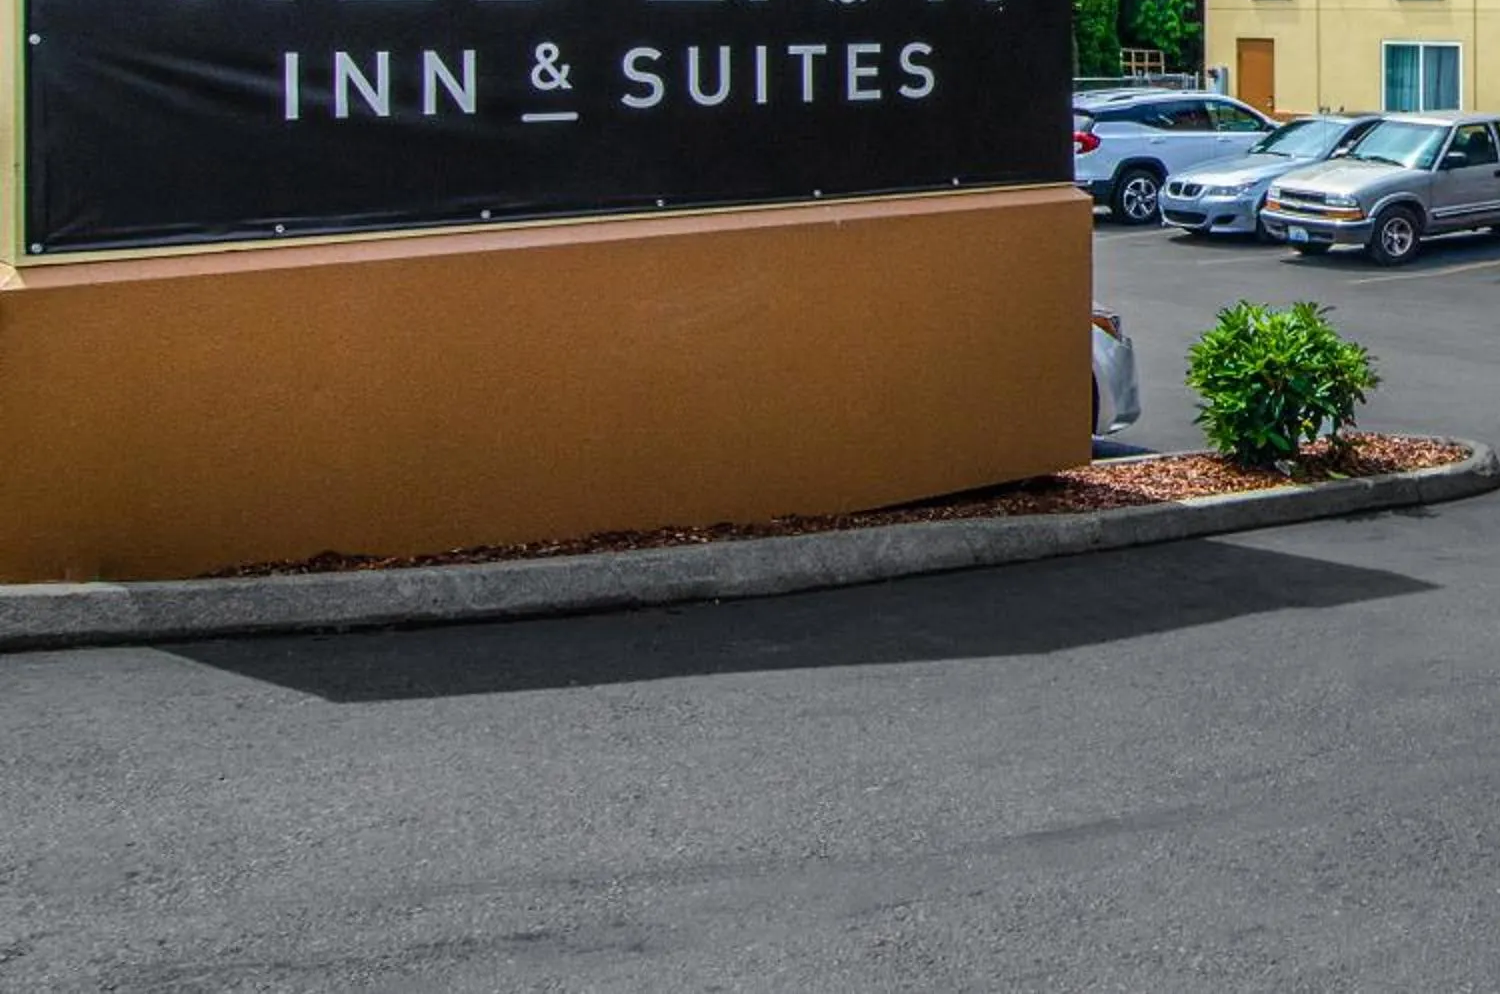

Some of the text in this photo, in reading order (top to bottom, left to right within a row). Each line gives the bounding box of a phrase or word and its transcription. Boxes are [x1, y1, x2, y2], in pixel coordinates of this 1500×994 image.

[285, 41, 935, 120] INN & SUITES
